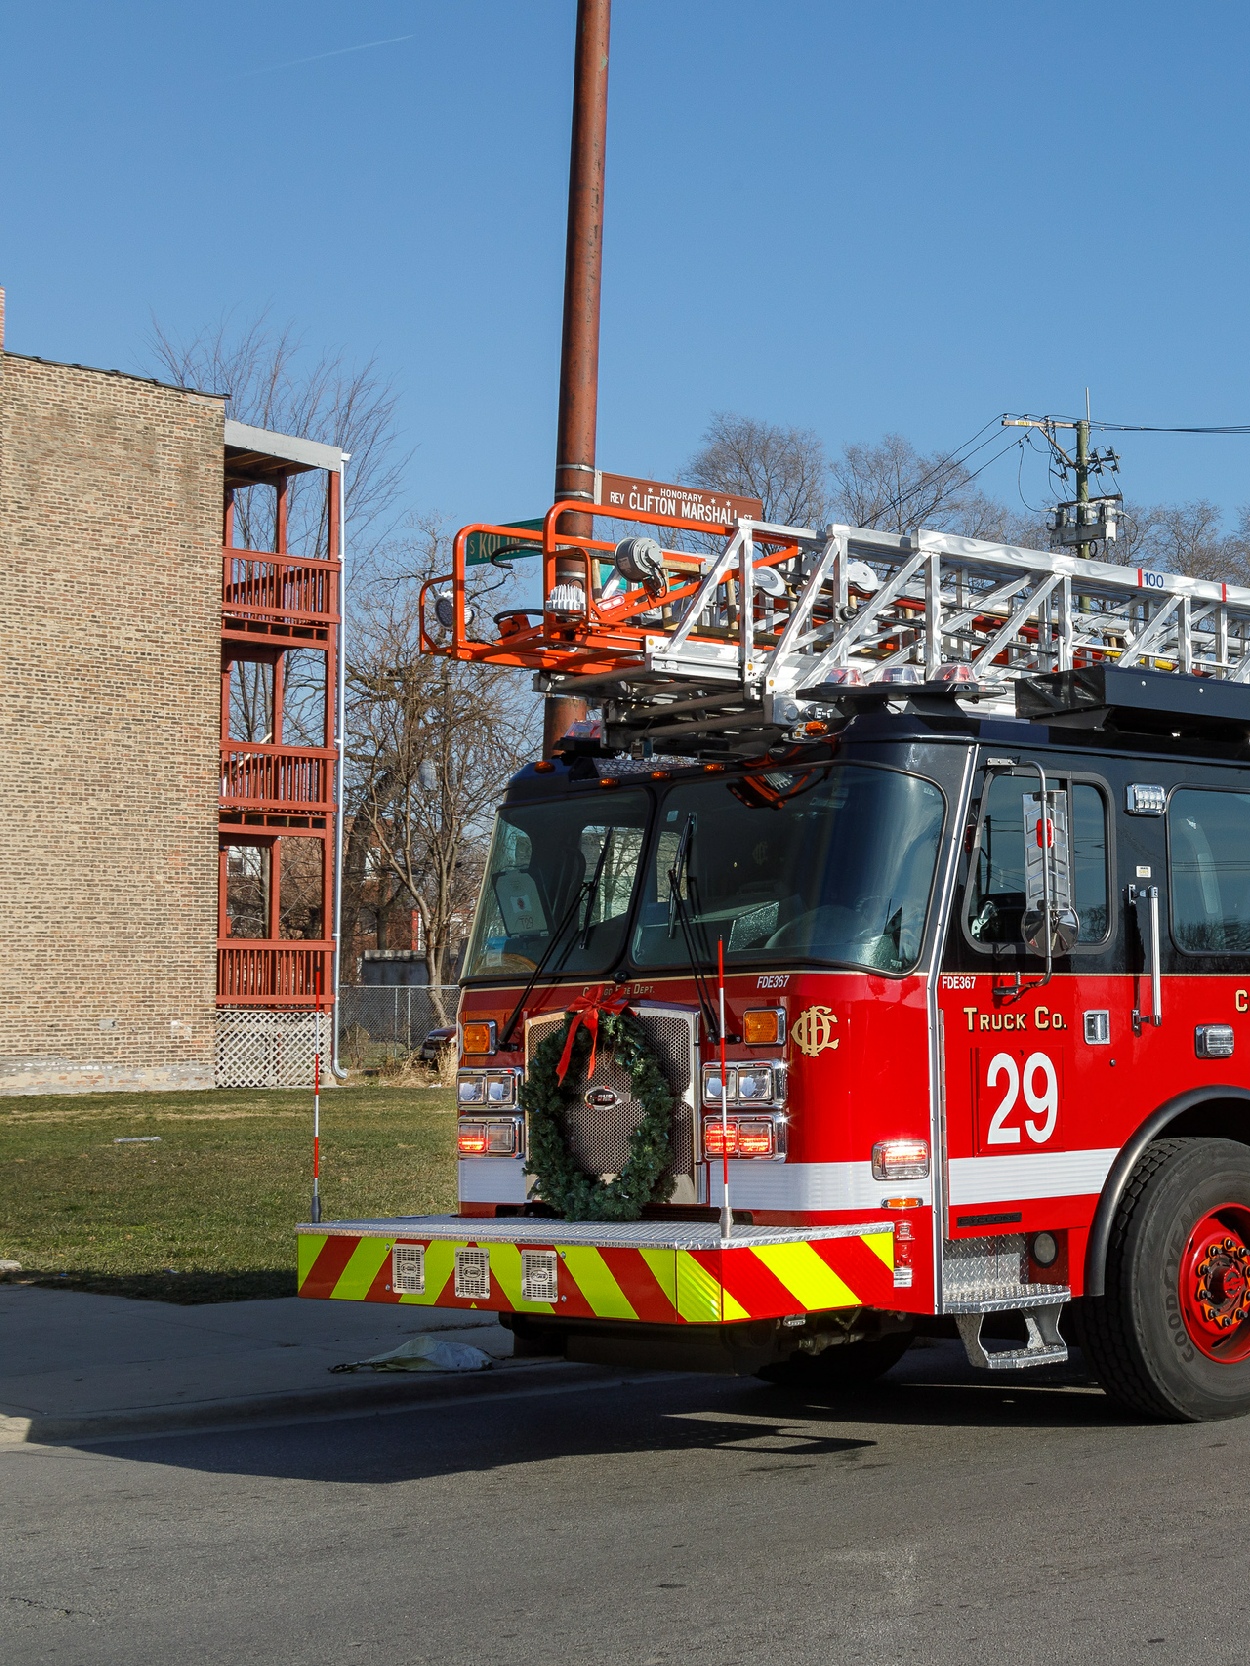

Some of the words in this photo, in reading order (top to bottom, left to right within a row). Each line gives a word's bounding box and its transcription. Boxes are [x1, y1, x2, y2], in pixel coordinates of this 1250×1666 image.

[610, 491, 625, 505] REV
[628, 492, 676, 516] CLIFTON
[660, 488, 703, 503] HONORARY
[469, 540, 476, 555] S
[1144, 572, 1164, 589] 100
[756, 975, 790, 989] FDE367
[942, 976, 976, 989] FDE367
[963, 1007, 1027, 1031] TRUCK
[986, 1052, 1058, 1145] 29
